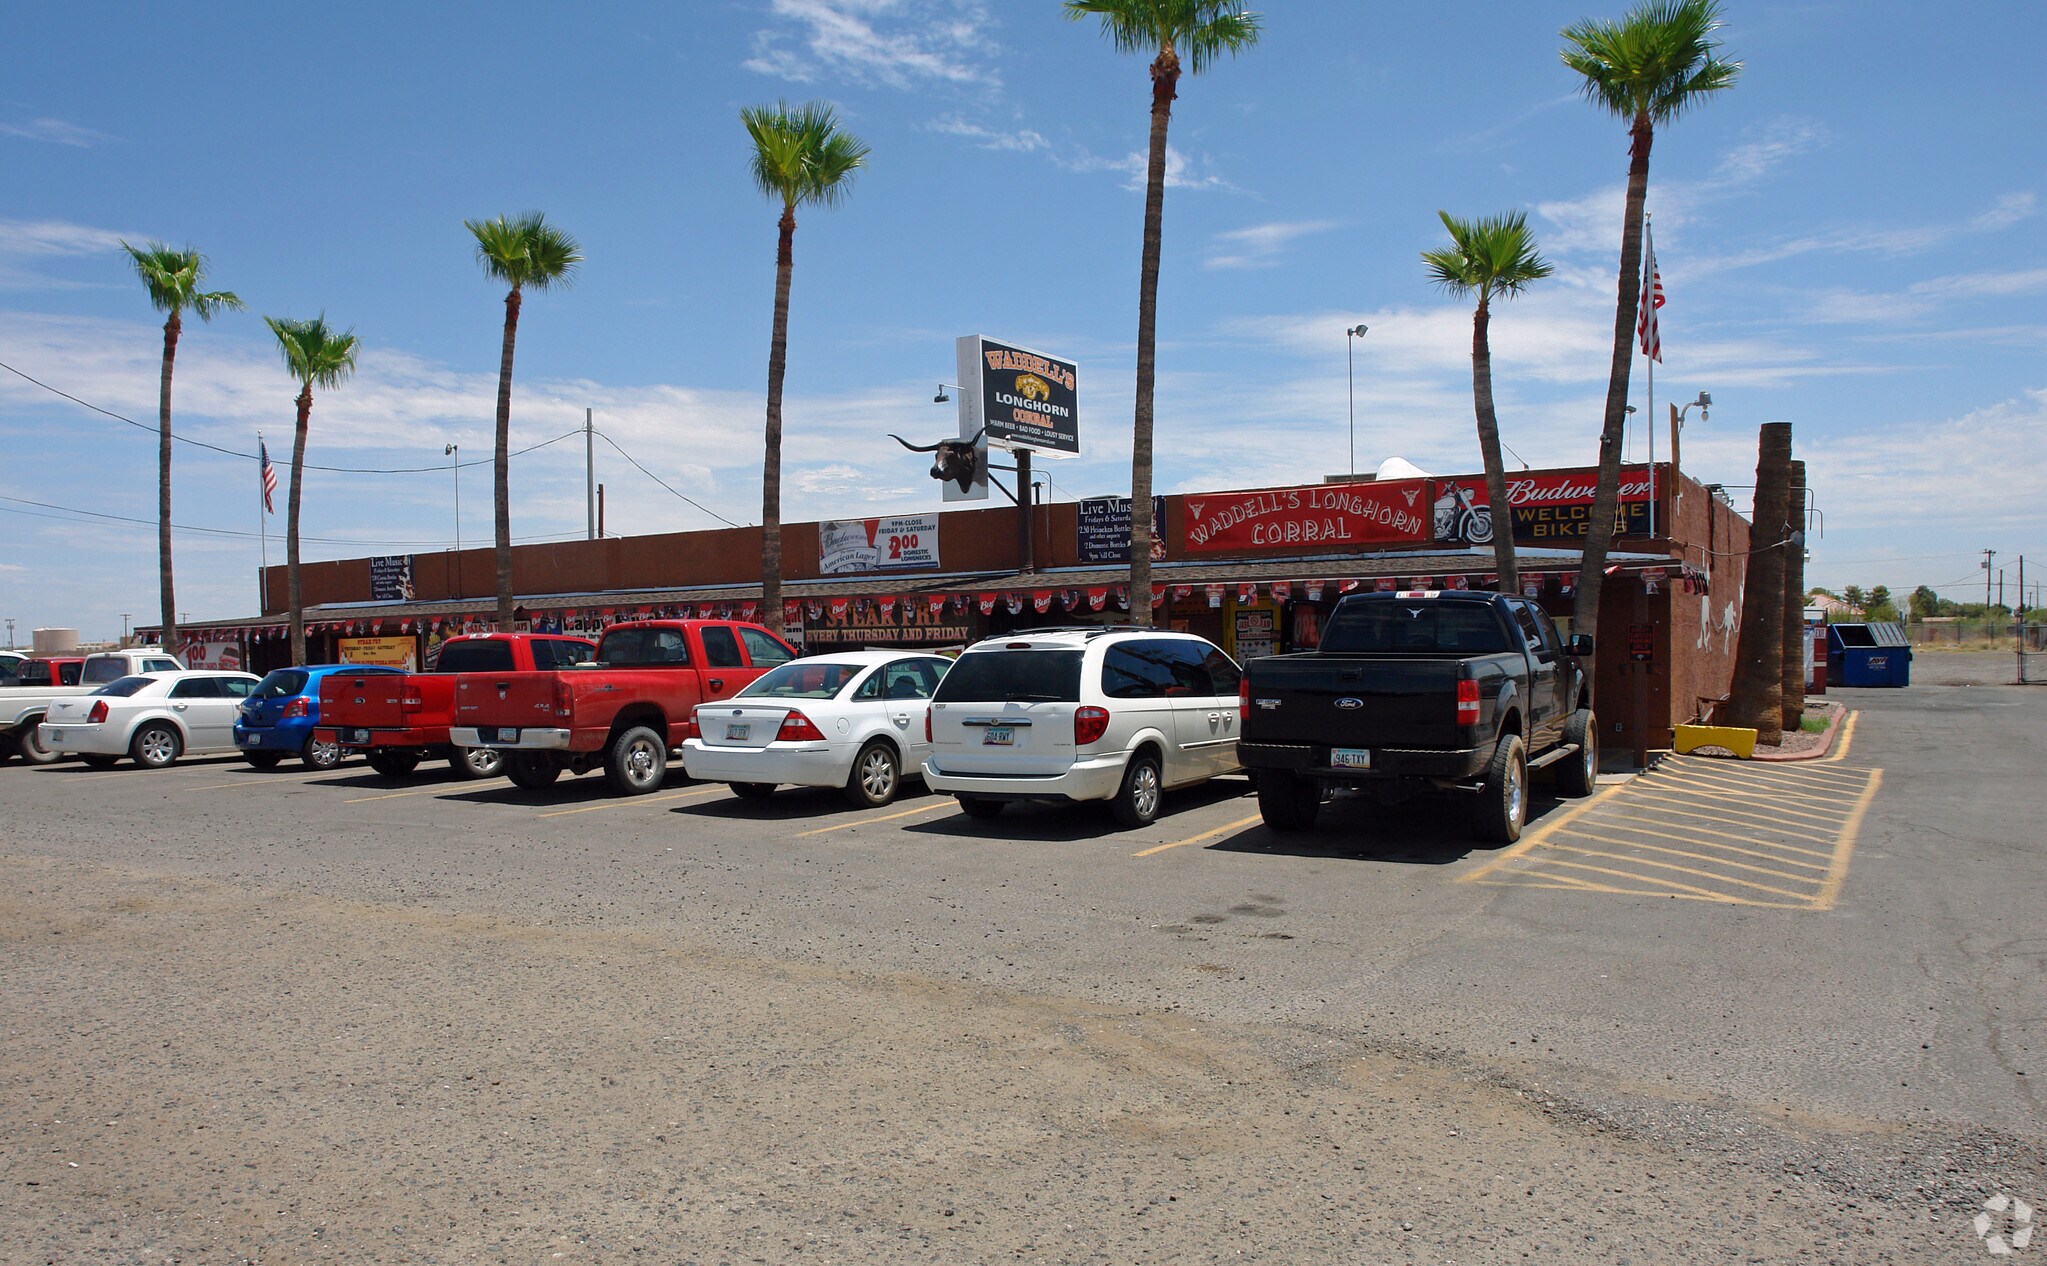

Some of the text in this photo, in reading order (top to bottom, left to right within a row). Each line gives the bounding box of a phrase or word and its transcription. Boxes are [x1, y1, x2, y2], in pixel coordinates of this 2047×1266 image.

[985, 350, 1075, 391] WADDELL'S
[995, 392, 1069, 418] LONGHORN
[1013, 408, 1054, 429] CORRAL
[1004, 422, 1015, 430] BEER
[1018, 425, 1028, 433] BAD
[1029, 426, 1042, 435] FOOD
[1058, 433, 1074, 442] SERVICE
[1080, 500, 1132, 515] Live Mus
[1190, 490, 1422, 545] WADDELL'S LONGHORN
[906, 524, 936, 532] SATURDAY
[1251, 516, 1351, 545] CORRAL
[1533, 521, 1627, 537] BIKES
[824, 552, 876, 571] American Lager
[1034, 596, 1051, 608] Bud
[1089, 593, 1106, 605] Bud
[832, 603, 847, 614] Bud
[806, 626, 968, 641] EVERY THURSDAY AND FRIDAY
[1335, 754, 1365, 764] 946 TXY
